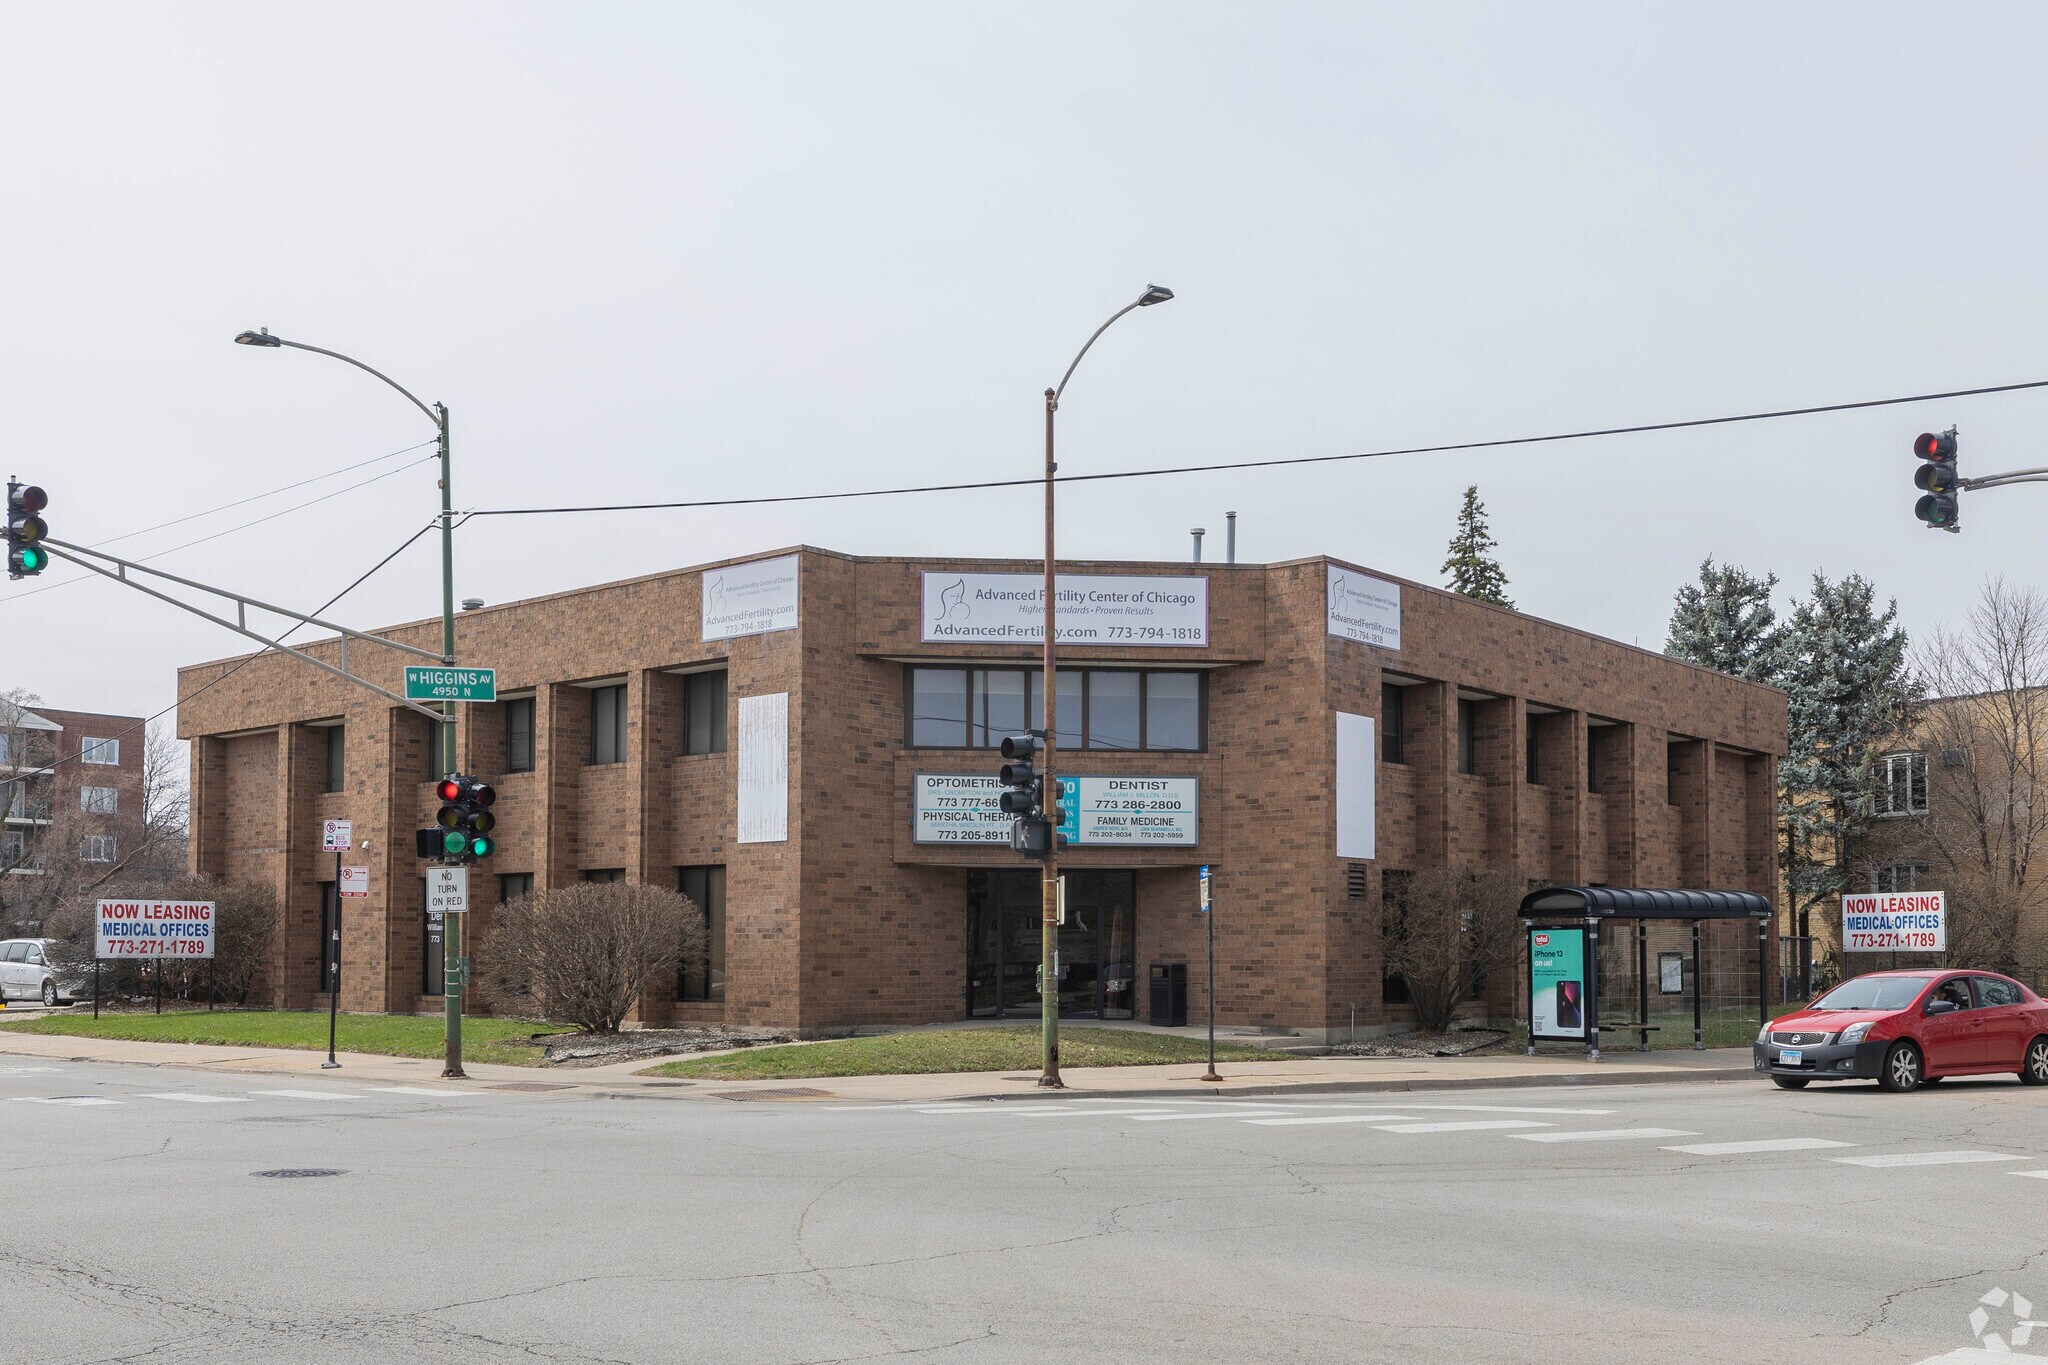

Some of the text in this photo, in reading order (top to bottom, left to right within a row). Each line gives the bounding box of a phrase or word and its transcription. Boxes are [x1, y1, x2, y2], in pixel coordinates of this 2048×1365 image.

[975, 588, 1036, 601] Advanced
[1089, 590, 1128, 602] Center
[1132, 591, 1144, 603] of
[1147, 592, 1195, 606] Chicago
[706, 605, 794, 625] AdvancedFertility.com
[1095, 606, 1123, 615] Proven
[1125, 606, 1154, 615] Results
[726, 619, 772, 634] 773-794-1818
[1331, 612, 1398, 636] AdvancedFertility.com
[934, 624, 1201, 639] AdvancedFertily.com 773-794-1818
[1347, 628, 1383, 644] 773-794-1818
[409, 672, 491, 685] W HIGGINS AV
[432, 687, 471, 696] 4950 N
[1109, 780, 1168, 790] DENTIST
[938, 798, 957, 807] 773
[1095, 800, 1181, 810] 773 286-2800
[924, 812, 974, 821] PHYSICAL
[1097, 817, 1174, 826] FAMILY MEDICINE
[938, 831, 1010, 840] 773 205-8911
[442, 872, 452, 881] NO
[437, 885, 457, 893] TURN
[433, 897, 462, 906] ON RED
[1846, 896, 1939, 913] NOW LEASING
[102, 904, 210, 920] NOW LEASING
[1847, 915, 1939, 930] MEDICAL OFFICES
[103, 923, 209, 936] MEDICAL OFFICES
[1852, 933, 1935, 947] 773-271-1789
[108, 940, 204, 954] 773-271-1789
